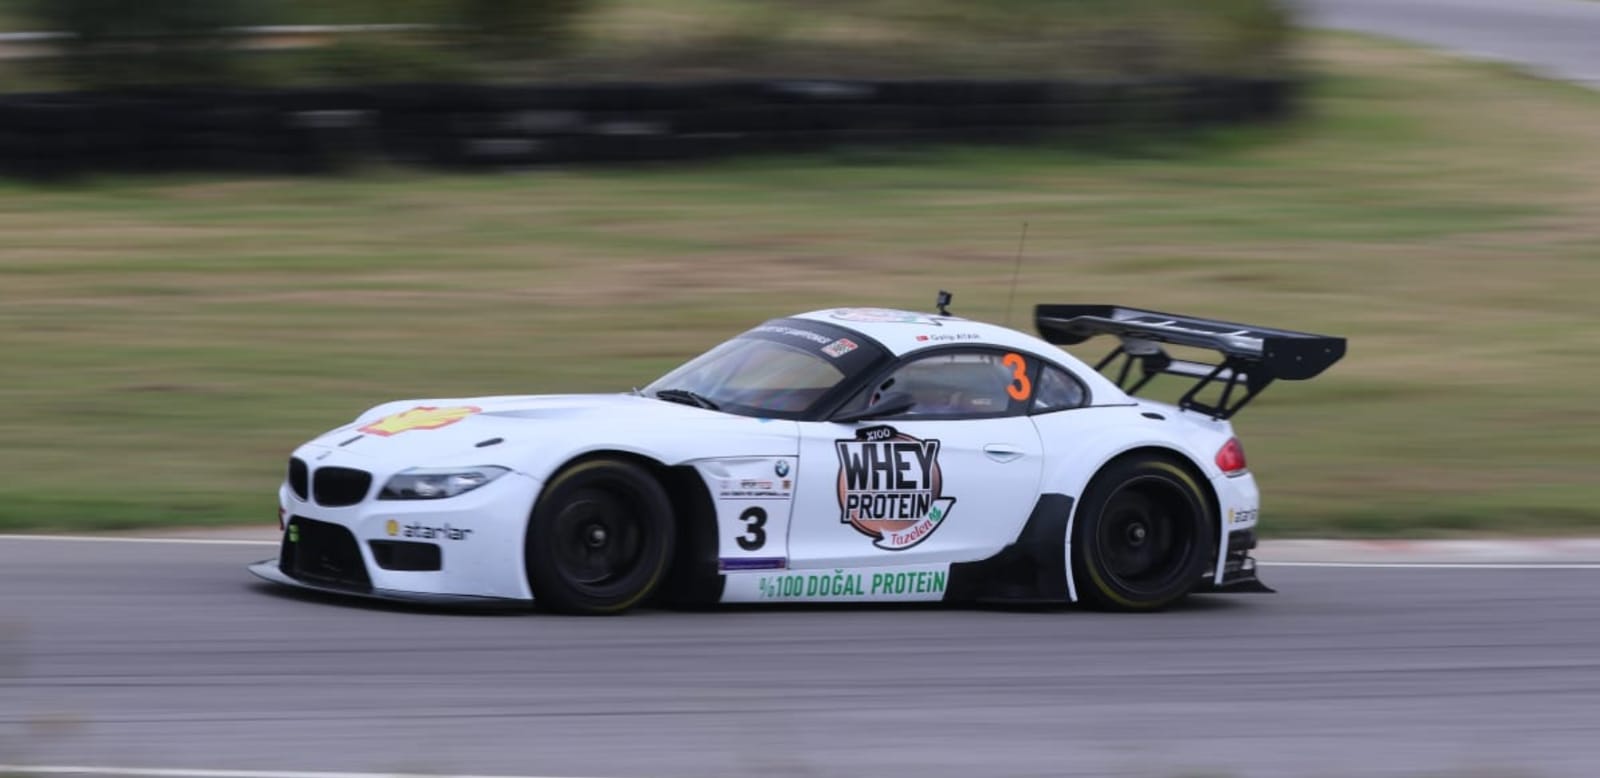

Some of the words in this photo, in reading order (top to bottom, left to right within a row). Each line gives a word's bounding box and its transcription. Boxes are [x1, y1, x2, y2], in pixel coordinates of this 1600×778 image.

[1003, 353, 1031, 401] 3
[840, 443, 936, 490] WHEY
[845, 493, 931, 519] PROTEIN
[403, 522, 473, 540] atarlar
[735, 505, 768, 552] 3
[892, 520, 932, 545] Tazelen
[759, 575, 804, 598] %100
[807, 568, 865, 597] DOĞAL
